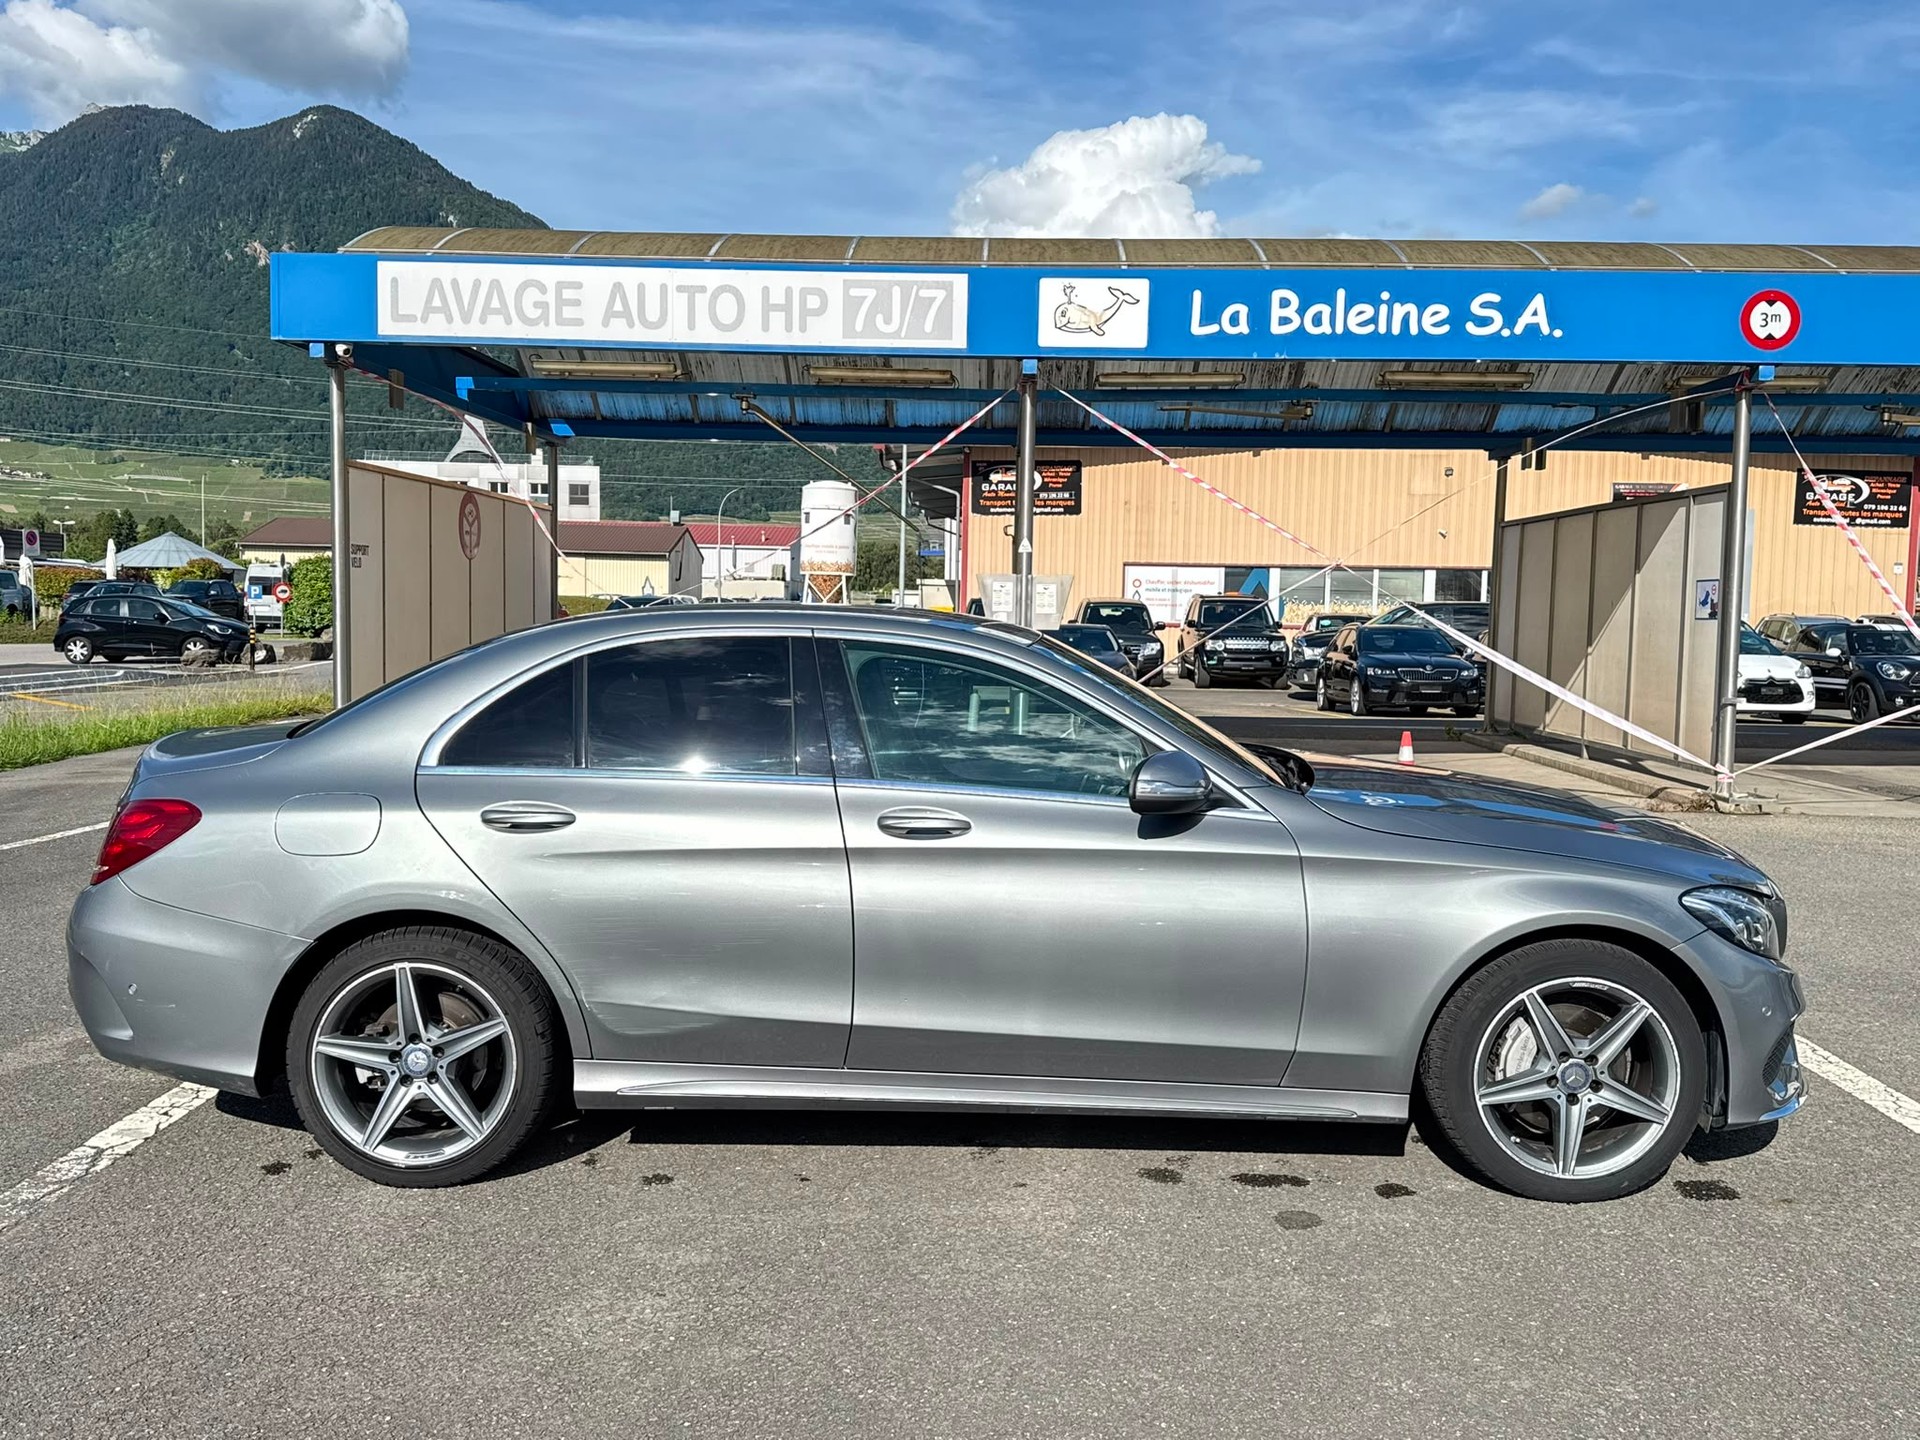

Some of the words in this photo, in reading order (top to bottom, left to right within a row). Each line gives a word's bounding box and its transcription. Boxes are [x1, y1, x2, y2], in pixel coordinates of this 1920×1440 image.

[390, 276, 585, 327] LAVAGE
[601, 281, 745, 333] AUTO
[761, 285, 829, 334] HP
[848, 284, 947, 338] 7J/7
[1190, 289, 1250, 336] La
[1269, 287, 1451, 336] Baleine
[1465, 292, 1563, 338] S.A.
[981, 483, 1016, 491] GARA
[1802, 508, 1831, 516] Transpo
[350, 543, 370, 556] SUPPORT
[250, 586, 260, 599] P
